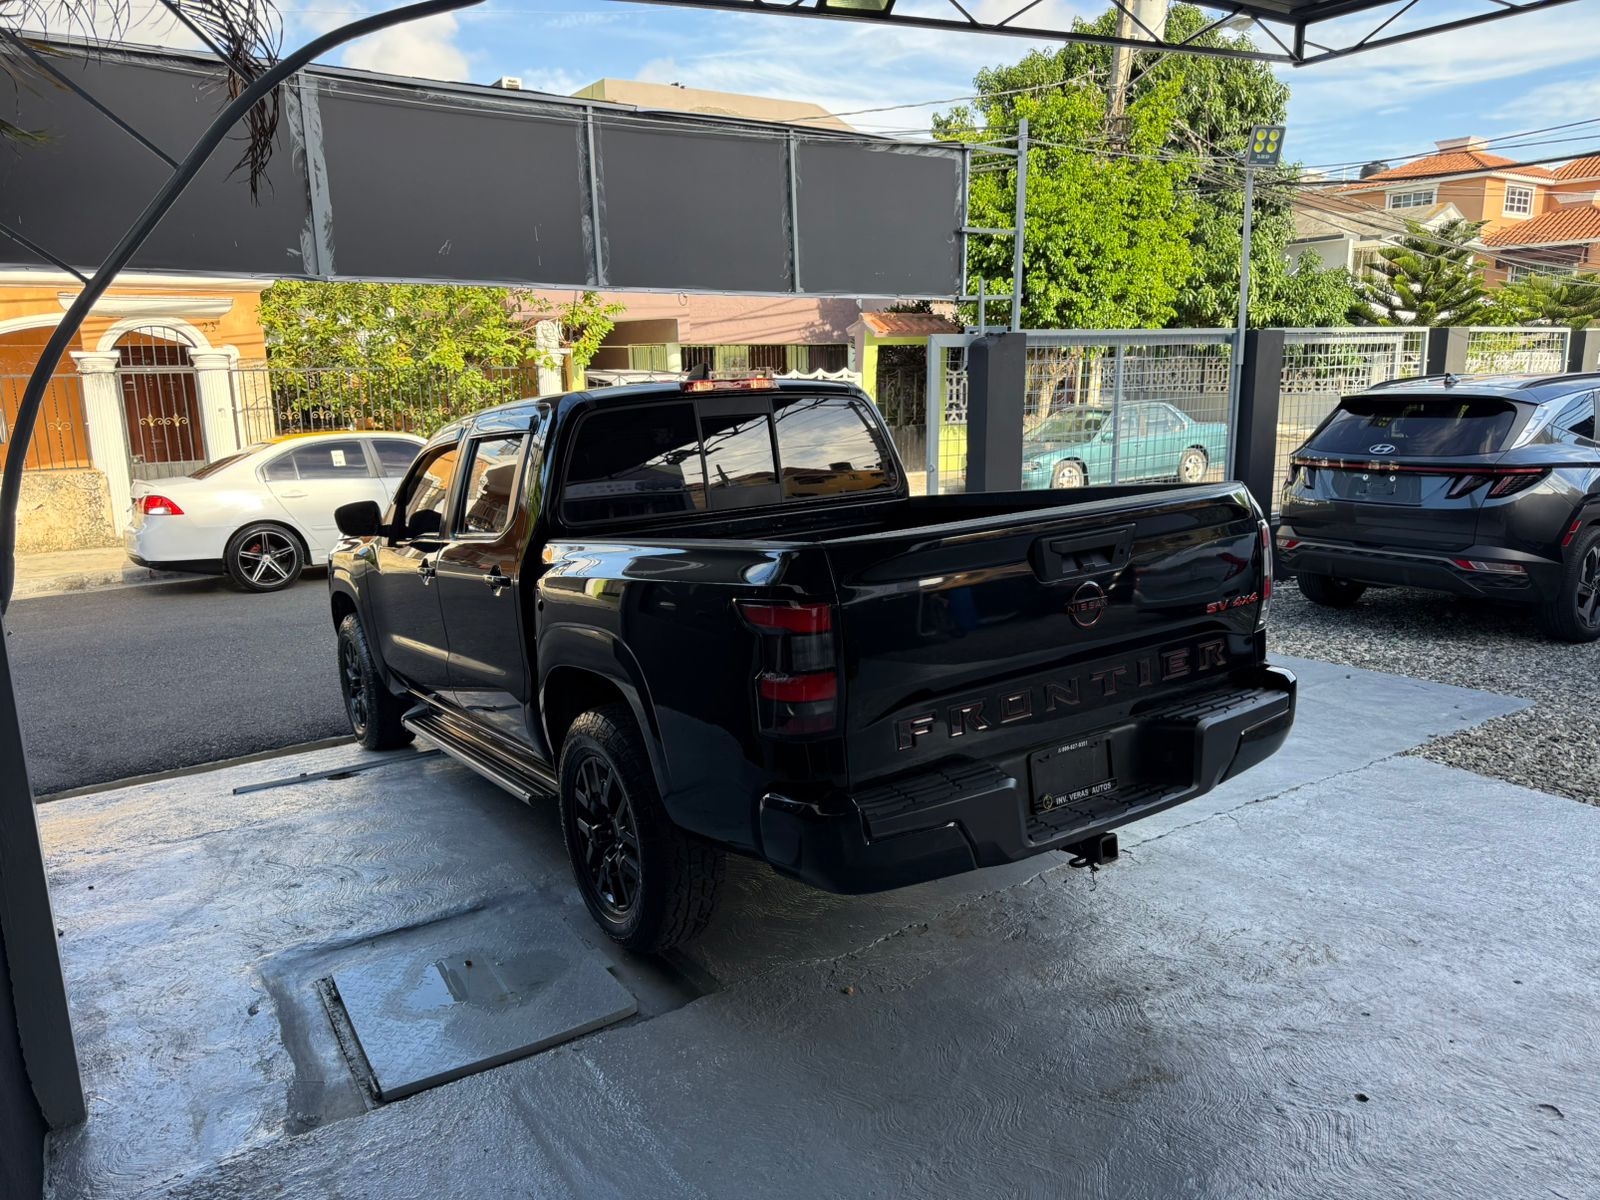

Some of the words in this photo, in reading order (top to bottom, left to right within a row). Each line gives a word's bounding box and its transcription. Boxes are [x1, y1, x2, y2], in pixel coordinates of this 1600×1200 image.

[202, 321, 216, 332] 23
[1066, 599, 1108, 614] NISSAN
[1206, 599, 1229, 614] SV
[897, 637, 1228, 752] FRONTIER
[1068, 788, 1089, 801] VERAS
[1091, 781, 1112, 794] AUTOS
